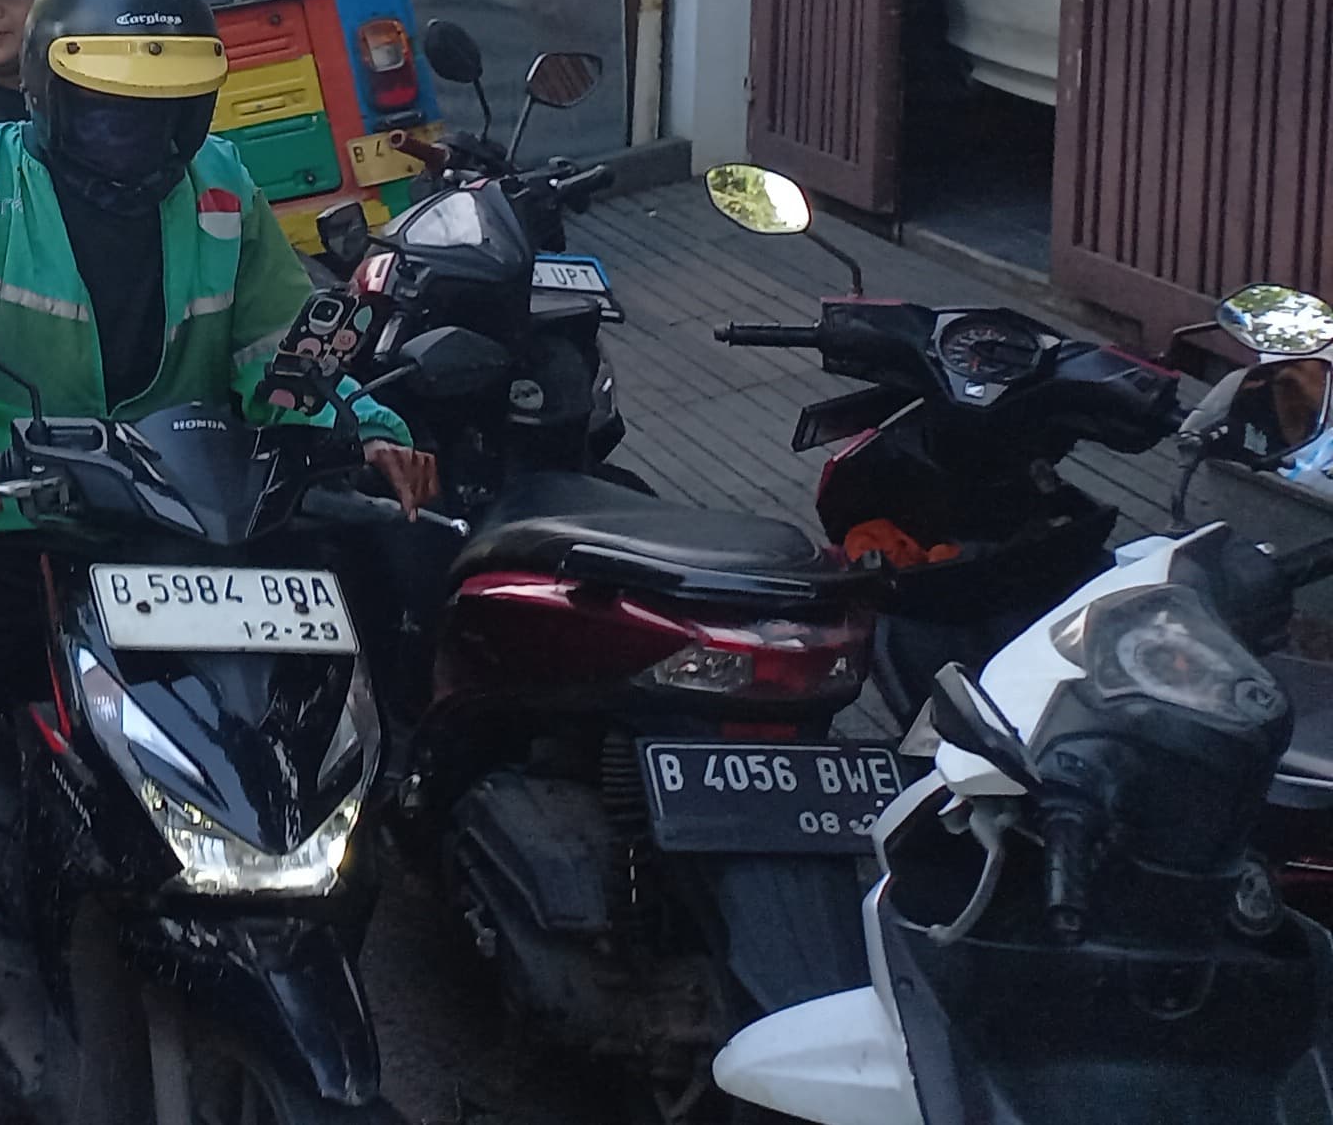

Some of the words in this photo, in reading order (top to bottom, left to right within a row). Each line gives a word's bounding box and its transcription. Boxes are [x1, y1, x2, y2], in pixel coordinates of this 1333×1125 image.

[353, 146, 365, 164] B
[550, 266, 593, 287] UPT
[173, 419, 228, 431] HONDA
[111, 574, 131, 605] B
[147, 574, 243, 604] 5984
[658, 753, 684, 792] B
[703, 754, 798, 792] 4056
[816, 757, 897, 795] BWE
